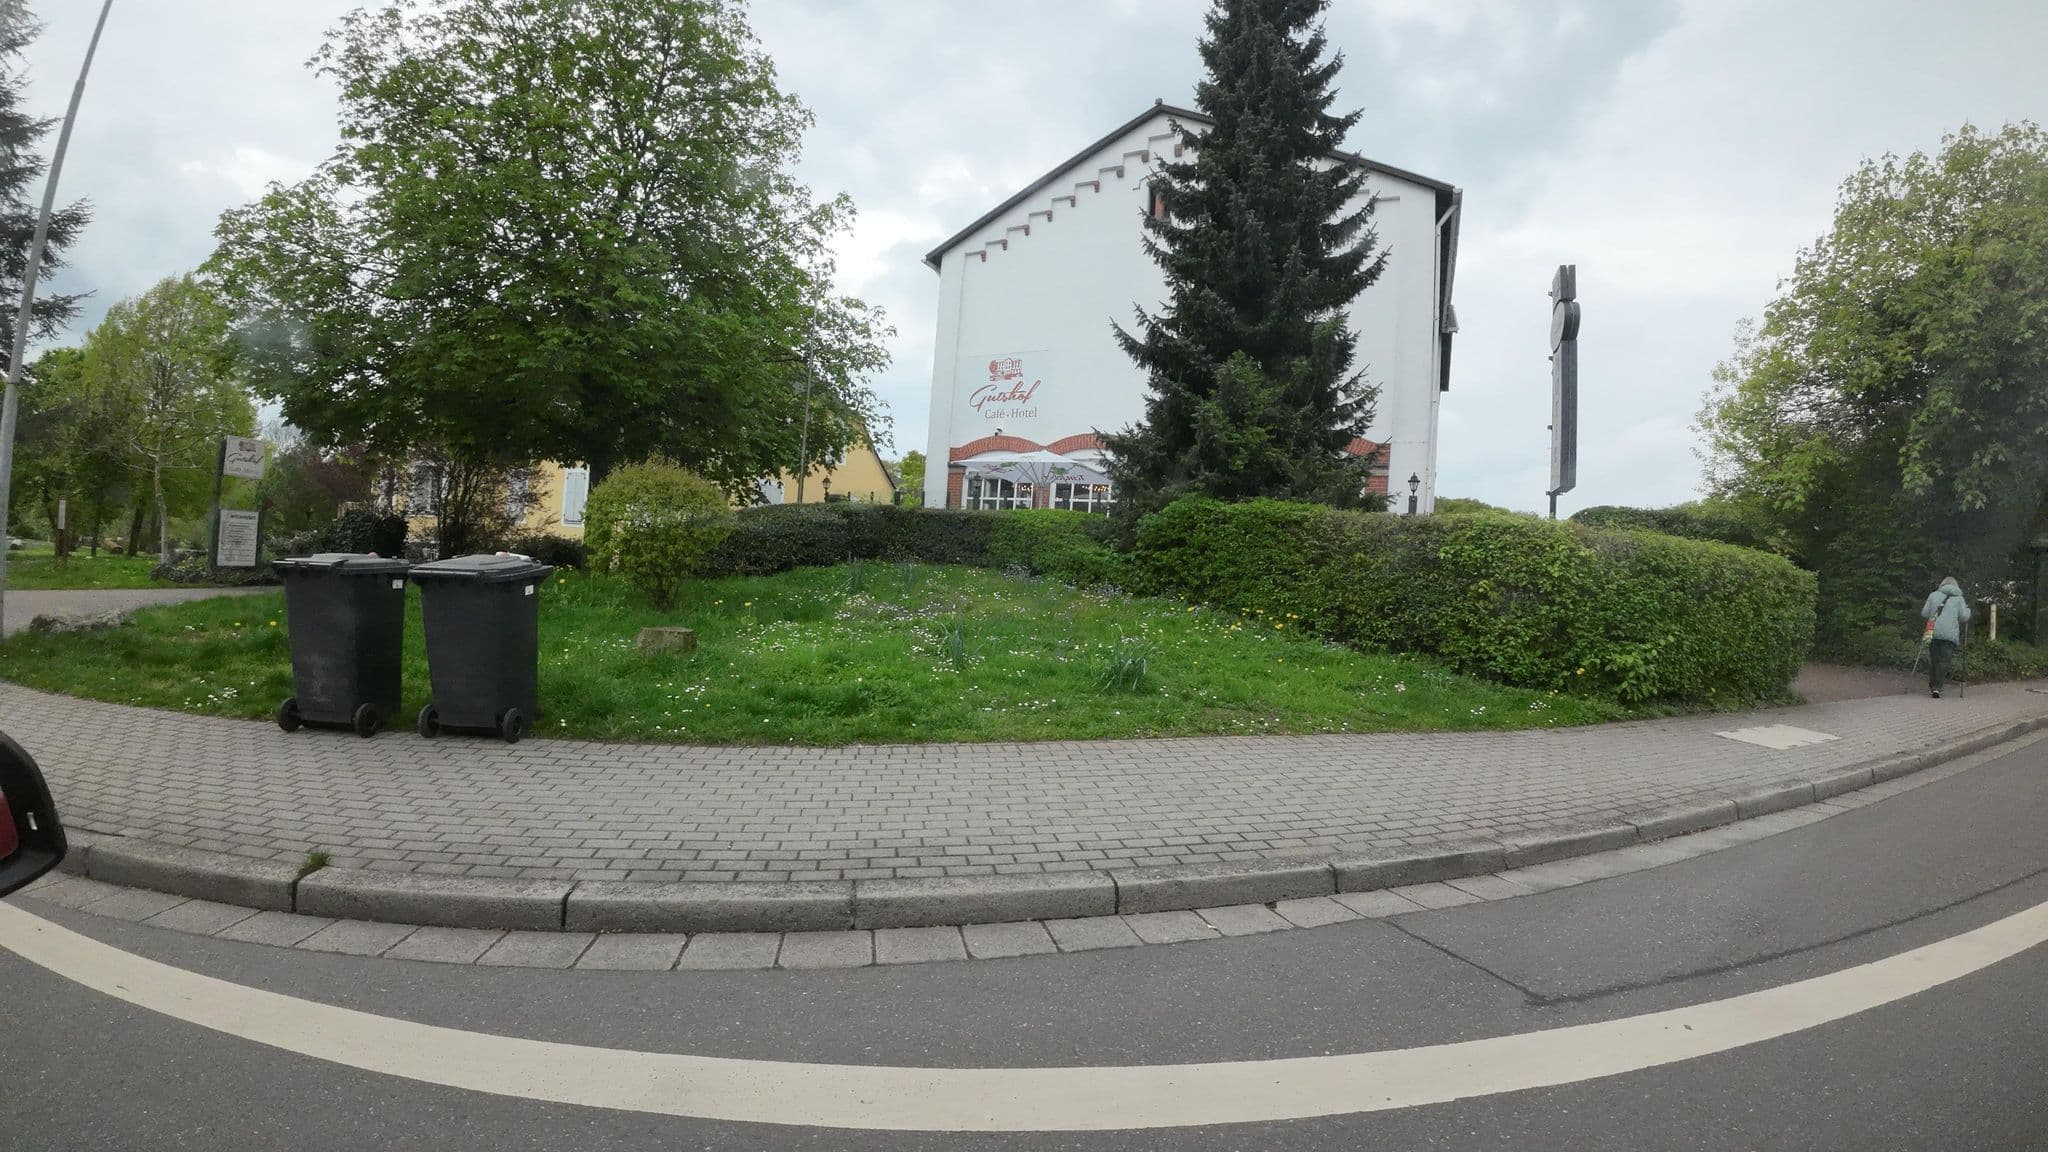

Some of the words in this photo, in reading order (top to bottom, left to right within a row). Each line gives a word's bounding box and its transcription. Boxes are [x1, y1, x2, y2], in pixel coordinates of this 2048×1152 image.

[969, 380, 1041, 412] Gutshof
[985, 407, 1005, 419] Café
[1011, 407, 1037, 418] Hotel
